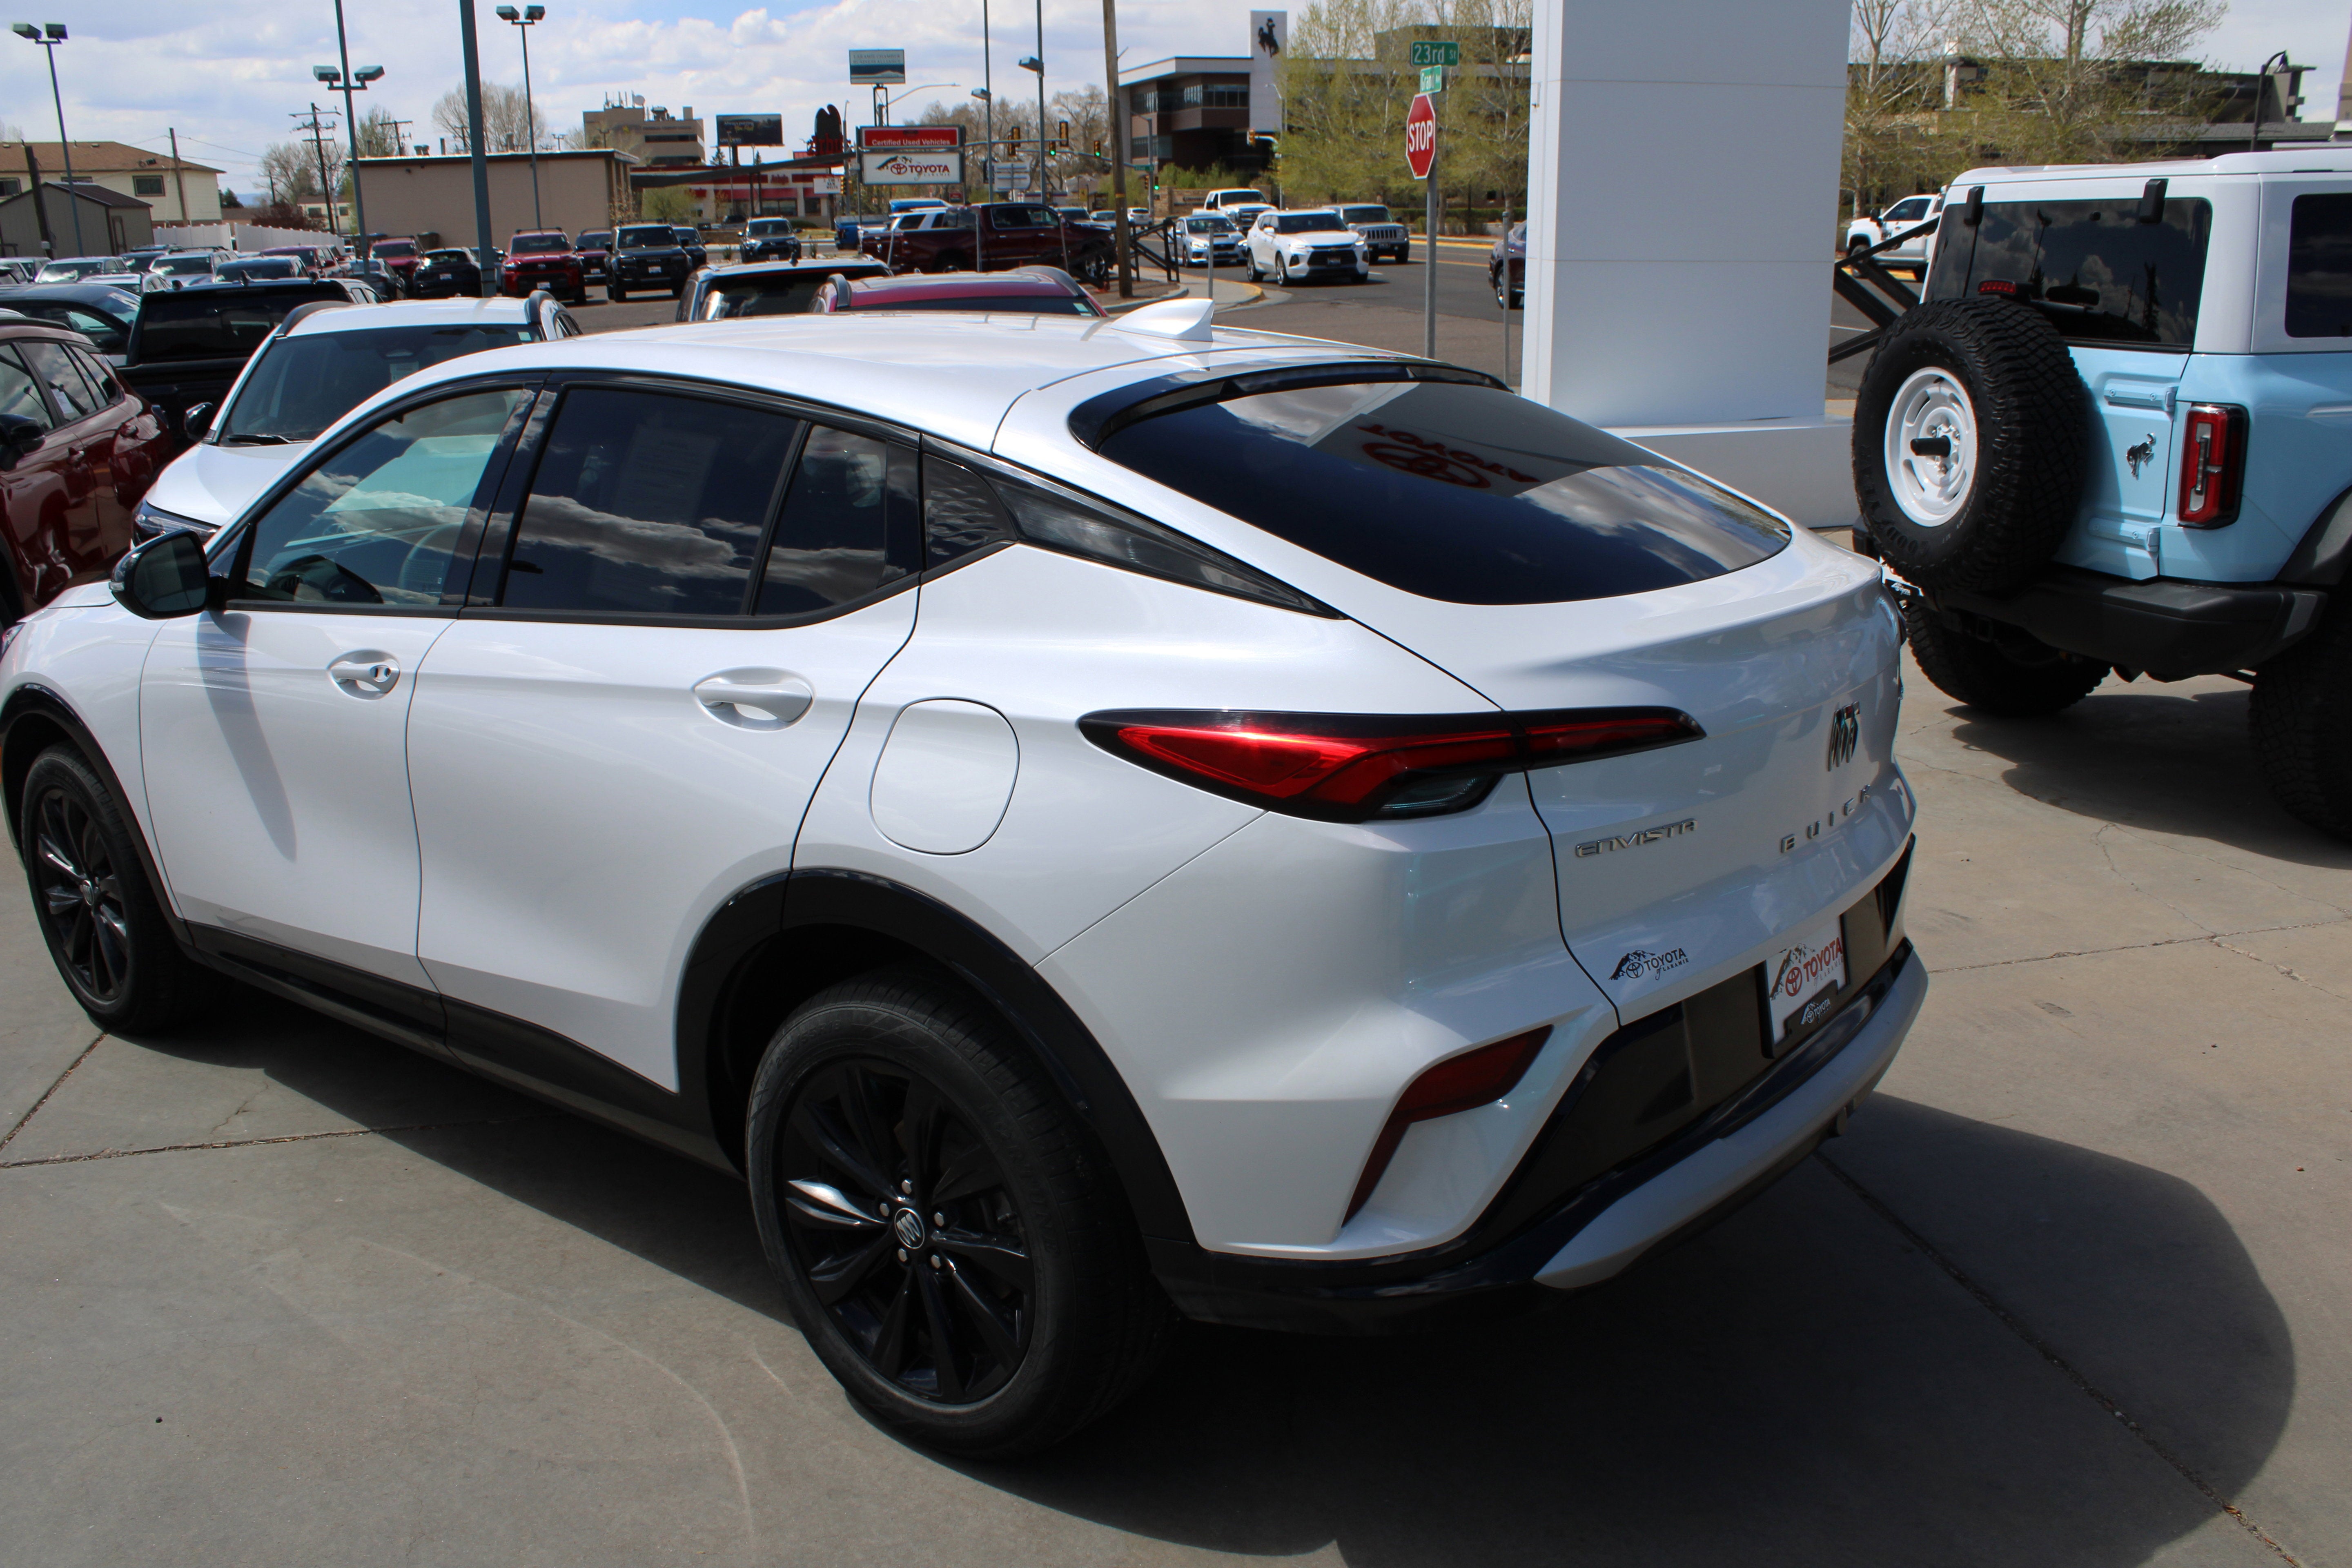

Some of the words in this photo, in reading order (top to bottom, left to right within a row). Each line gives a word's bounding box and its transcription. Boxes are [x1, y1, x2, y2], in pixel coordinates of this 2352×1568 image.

[1414, 44, 1445, 64] 23rd
[1449, 49, 1456, 60] St
[1409, 120, 1433, 153] STOP
[908, 165, 950, 173] TOYOTA
[1780, 784, 1871, 853] BUICK
[1575, 817, 1698, 858] ENVISTA
[1643, 947, 1687, 971] TOYOTA
[1663, 958, 1689, 971] LARAMIE
[1803, 937, 1843, 982] TOYOTA
[1814, 998, 1831, 1017] TOYOTA
